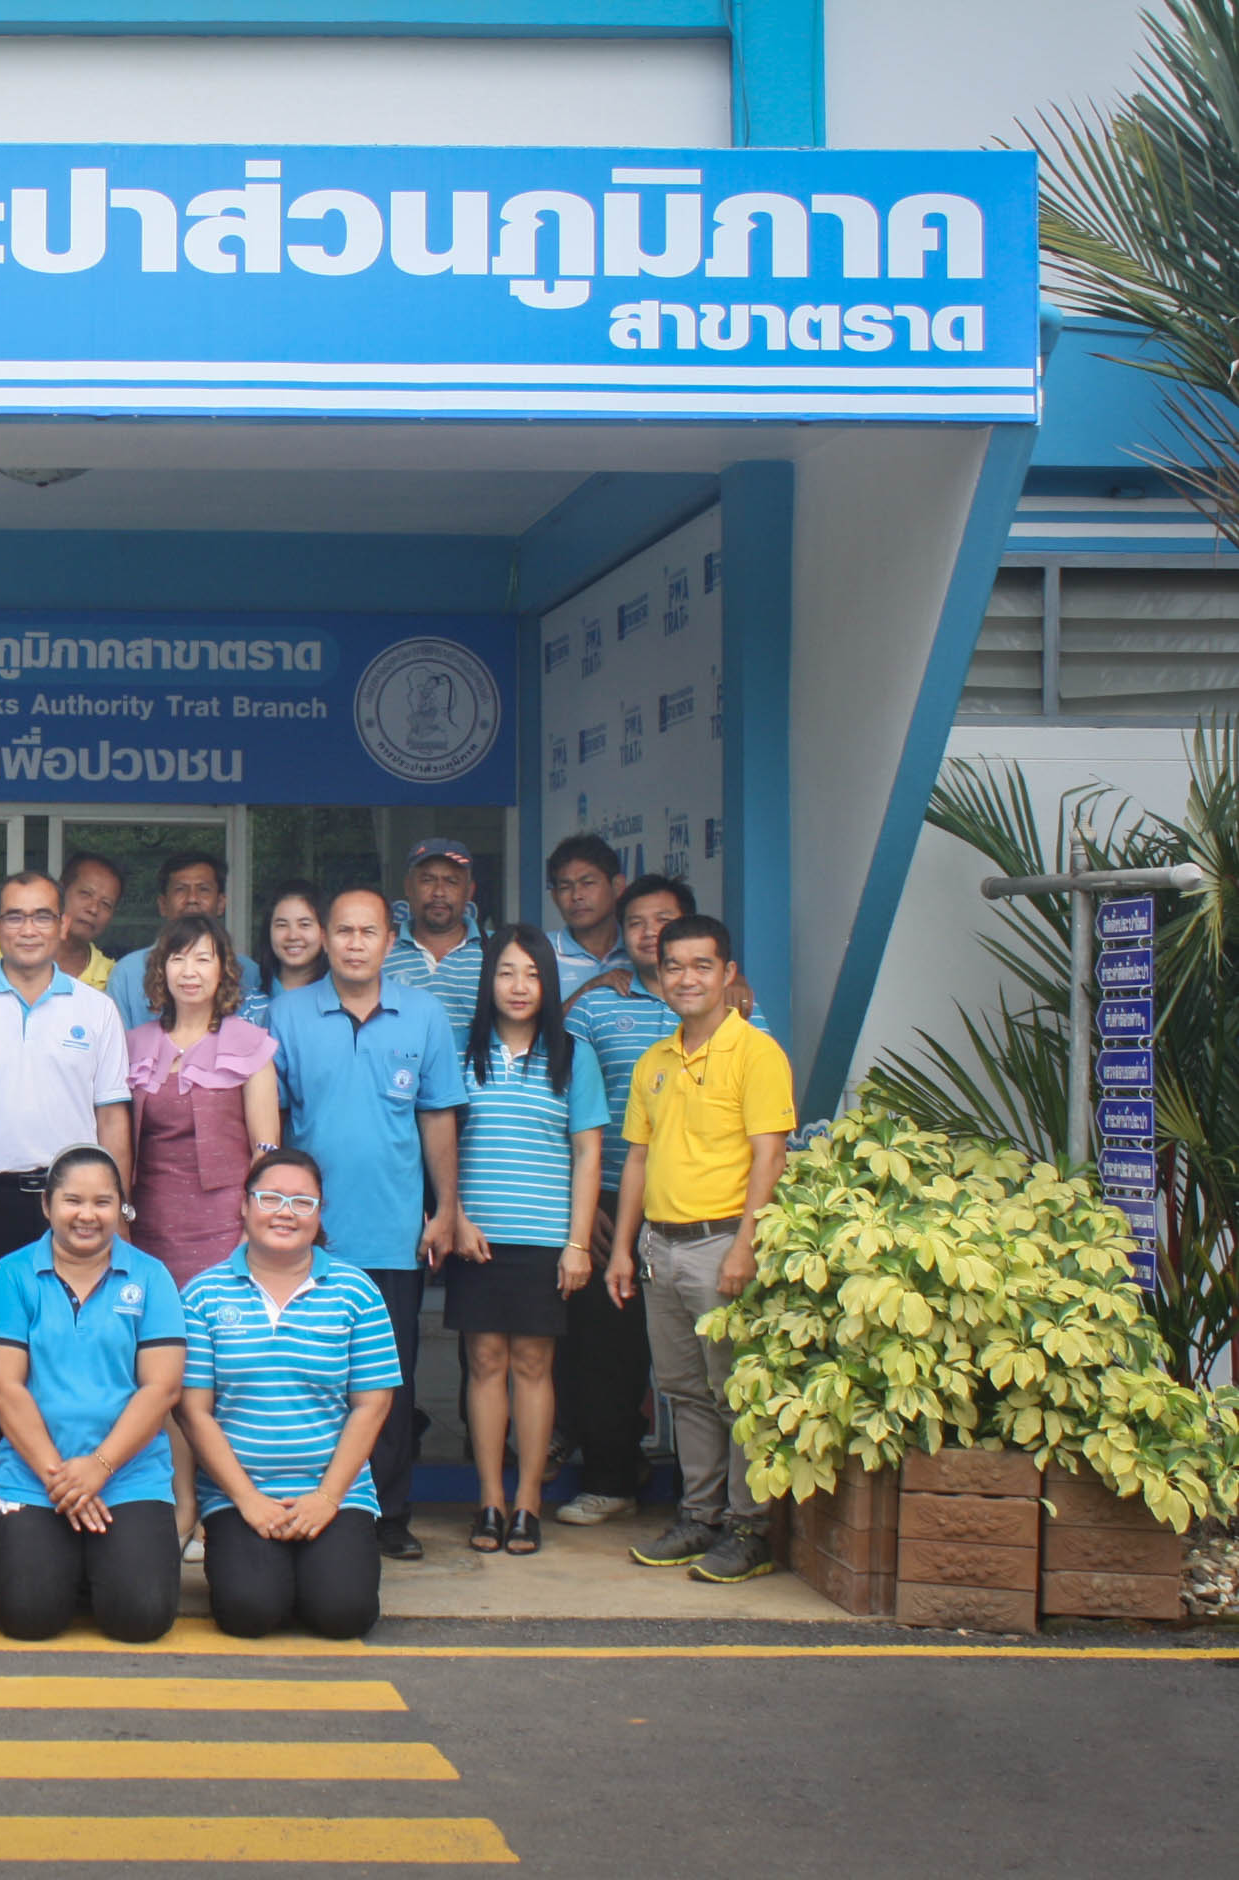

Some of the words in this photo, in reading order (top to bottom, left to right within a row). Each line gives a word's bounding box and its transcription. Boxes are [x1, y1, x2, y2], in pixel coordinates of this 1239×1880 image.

[609, 300, 984, 353] สาขาตราด
[31, 694, 154, 721] Authority
[166, 695, 221, 718] Trat
[233, 696, 328, 719] Branch
